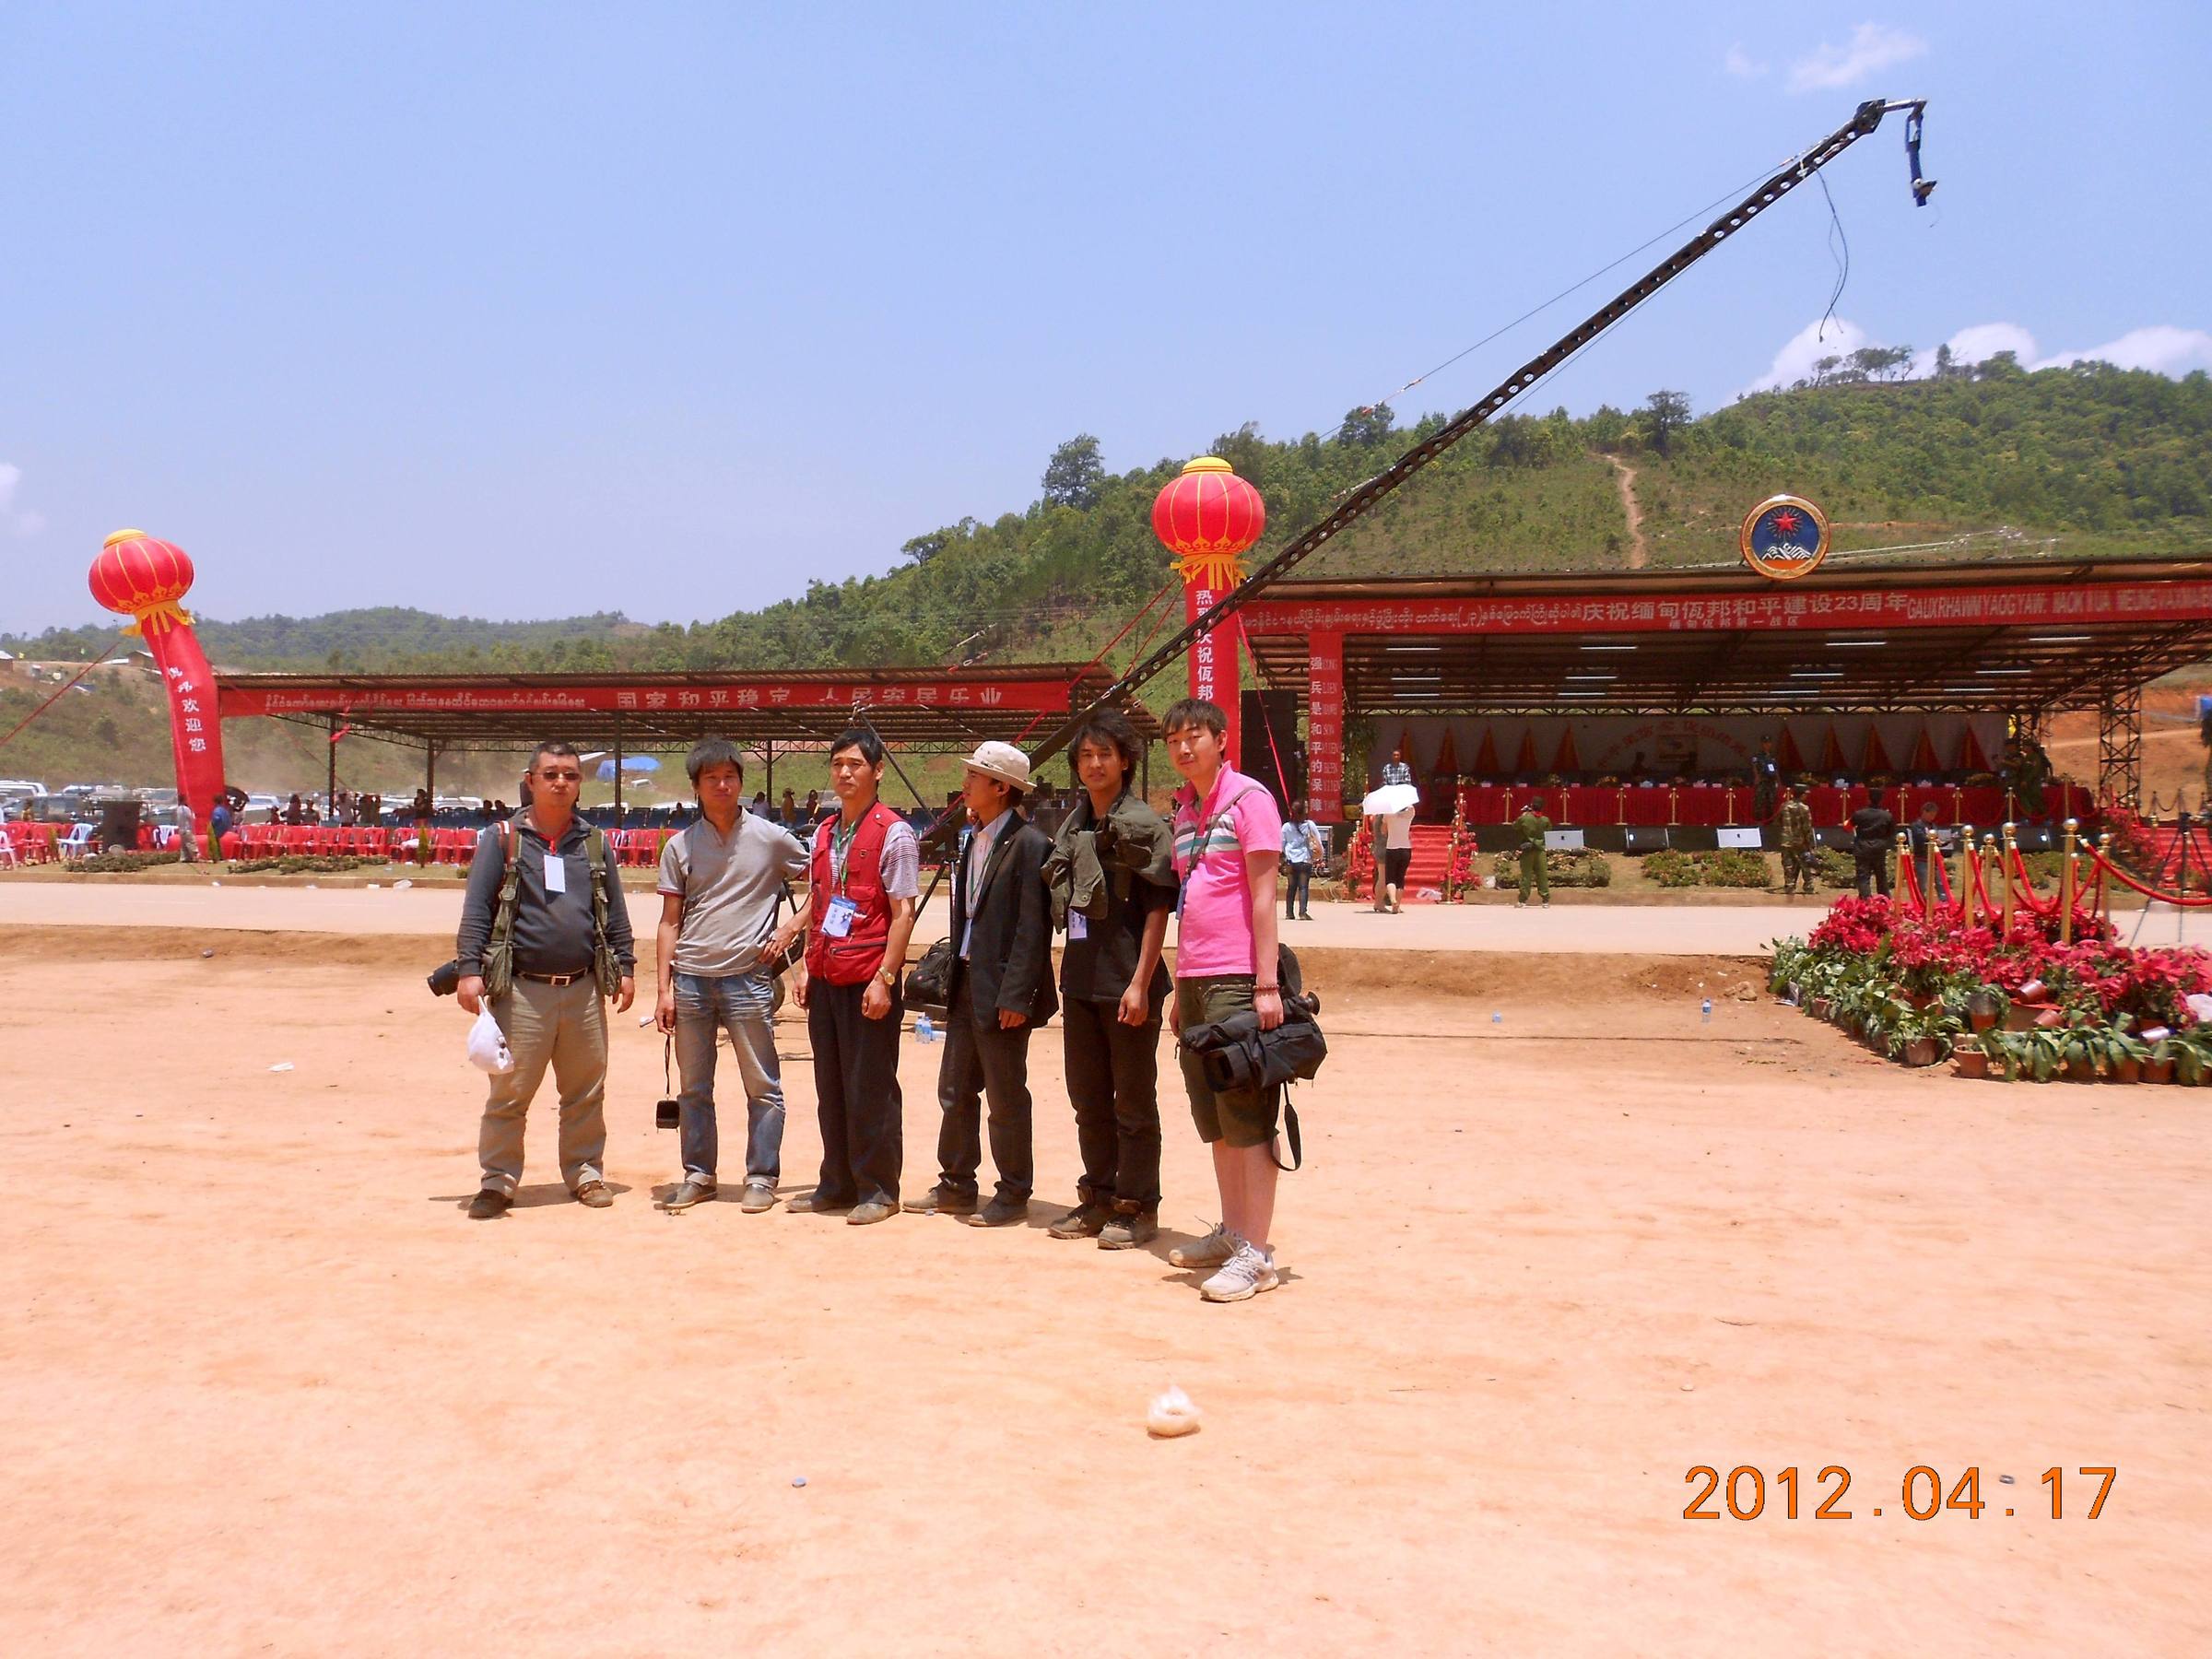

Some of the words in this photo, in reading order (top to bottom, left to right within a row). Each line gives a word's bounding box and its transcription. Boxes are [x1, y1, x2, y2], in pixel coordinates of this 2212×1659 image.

[1582, 593, 1908, 621] 庆祝缅甸佤邦和平建设23周年
[617, 688, 790, 709] 国家和平稳定
